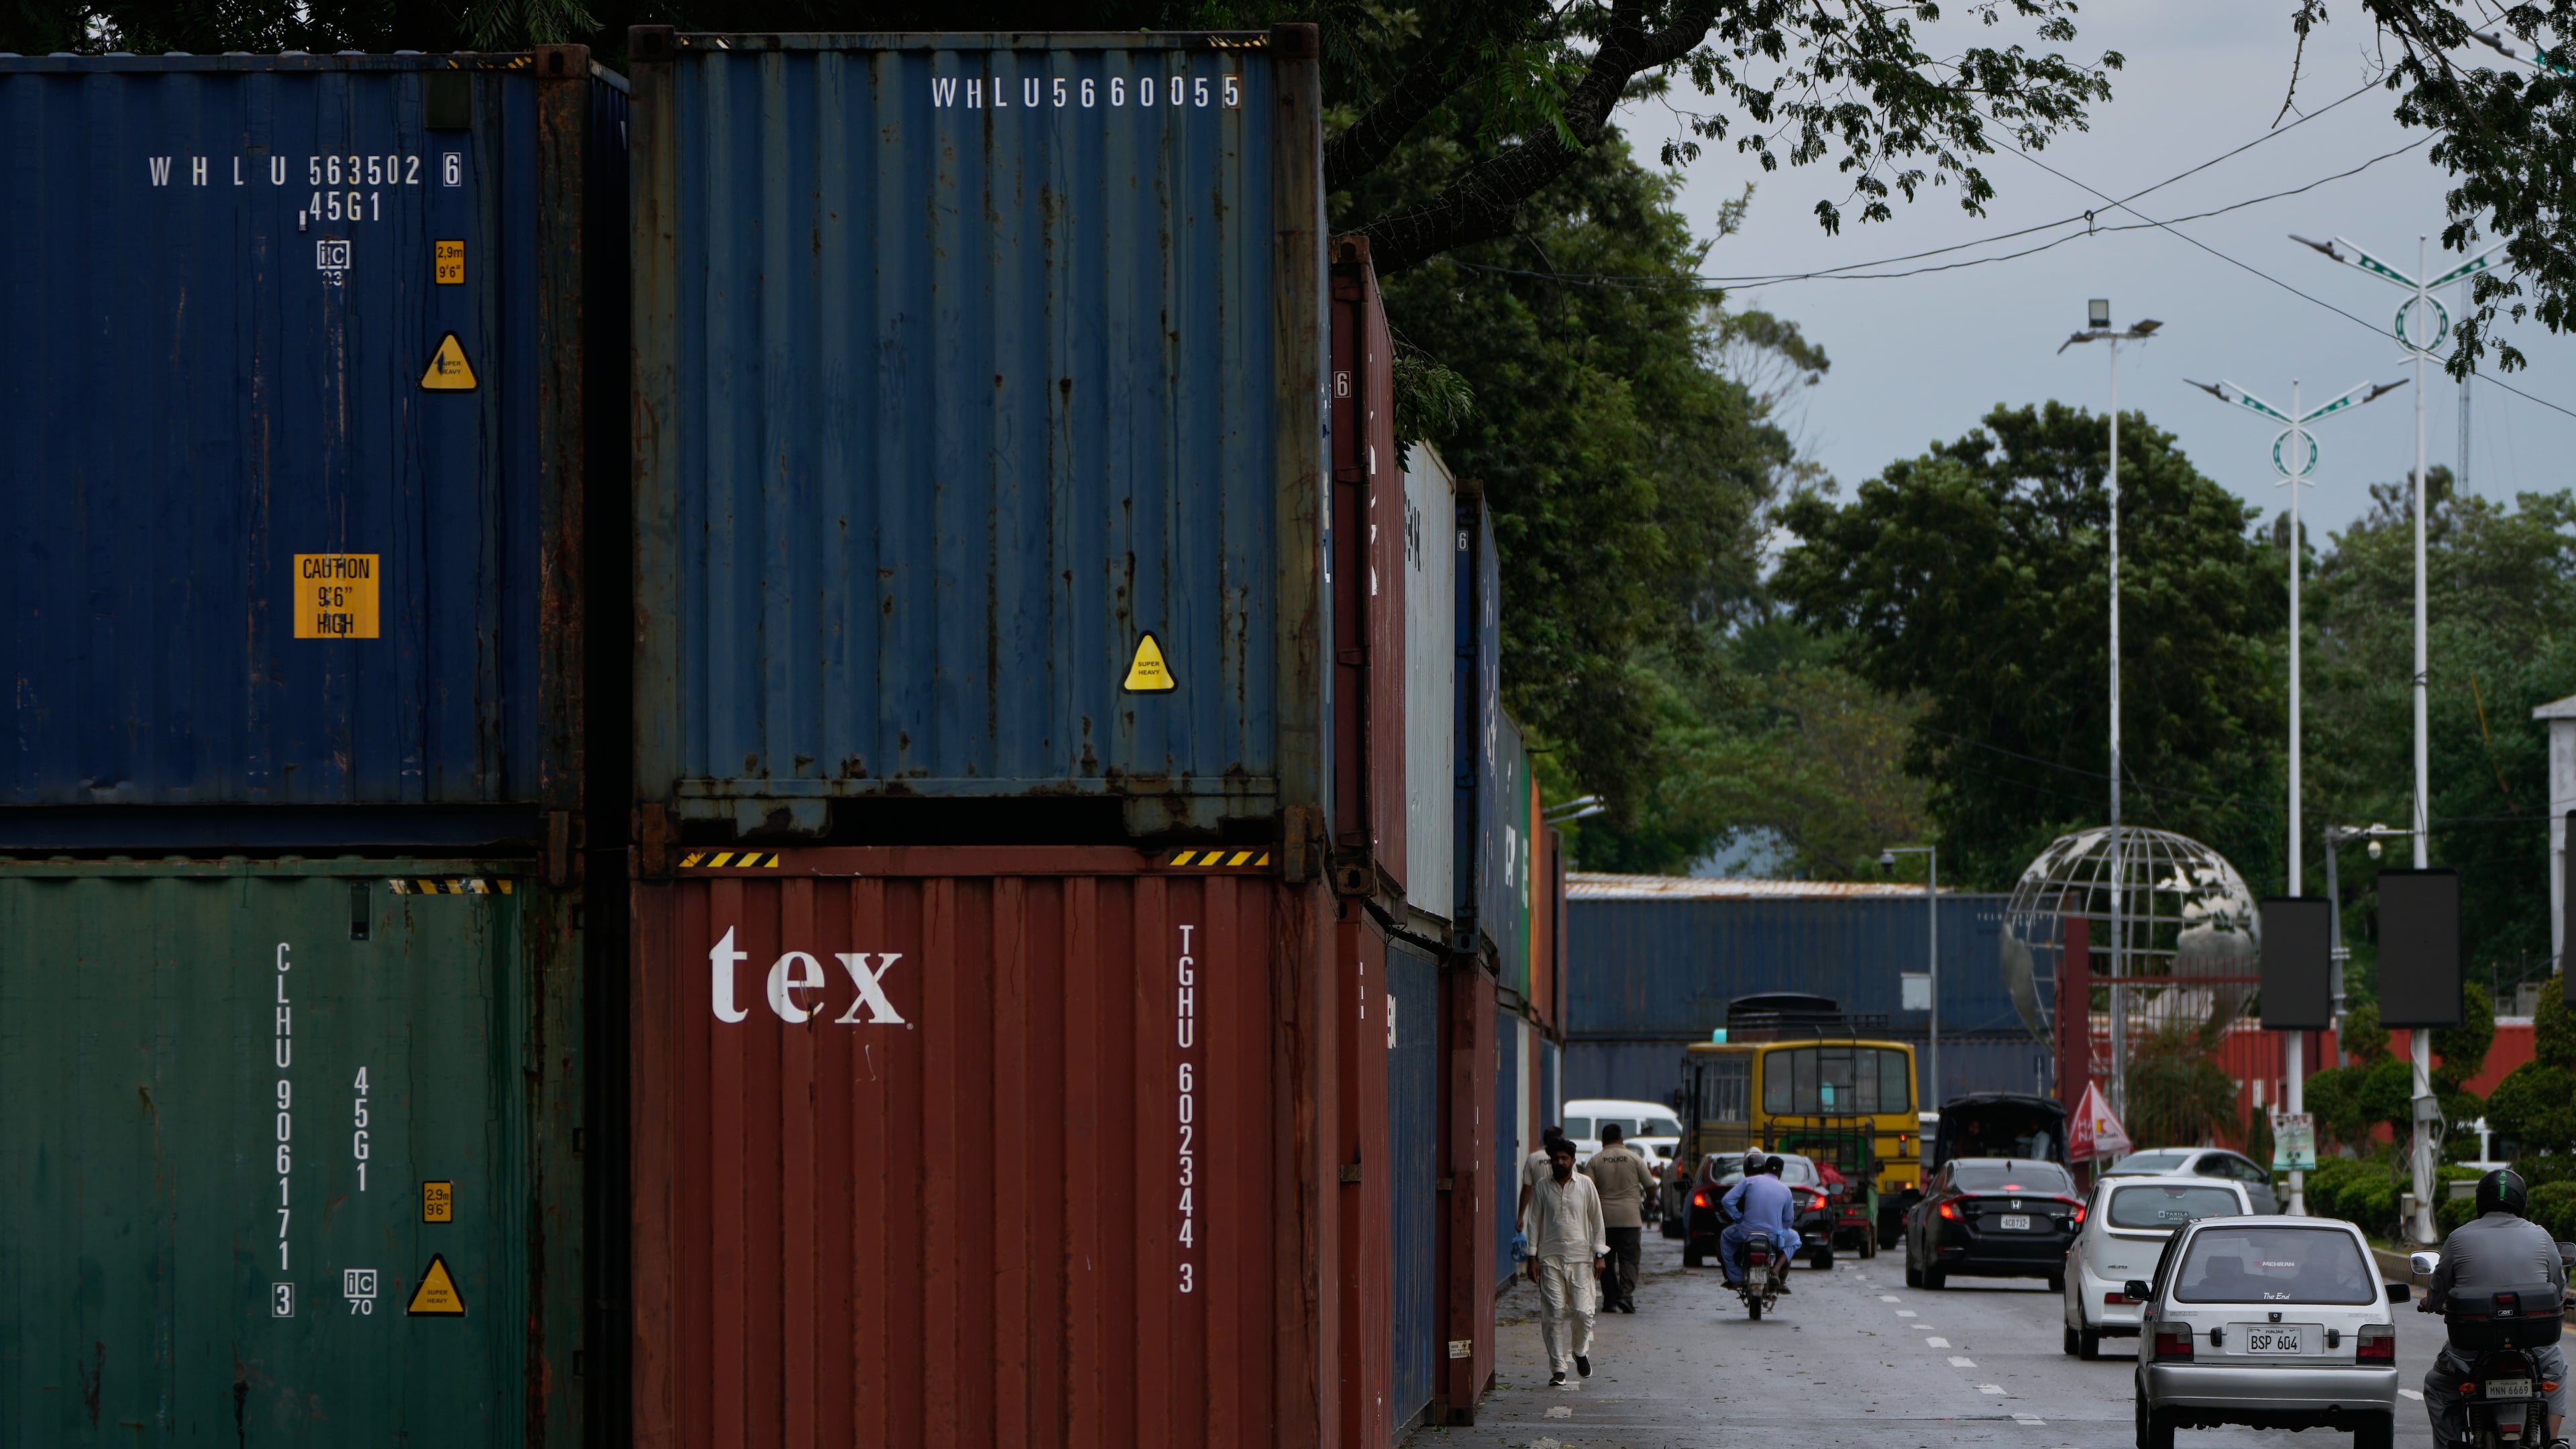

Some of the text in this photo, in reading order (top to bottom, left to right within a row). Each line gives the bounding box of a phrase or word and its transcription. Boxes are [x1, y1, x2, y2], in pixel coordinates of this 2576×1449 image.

[309, 155, 419, 185] 563502
[445, 154, 459, 184] 6
[309, 191, 381, 221] 45G1
[1337, 373, 1348, 396] 6
[1458, 532, 1468, 550] 6
[303, 558, 370, 579] CAUTION
[317, 613, 354, 633] HIGH
[709, 925, 906, 1024] tex
[1179, 925, 1193, 1293] TGHU 602344 3
[276, 943, 290, 1315] CLHU 906171 3
[354, 1067, 368, 1191] 45G1
[349, 1300, 372, 1316] 70
[2251, 1336, 2297, 1350] BSP 604
[2490, 1386, 2528, 1395] MNN 6669
